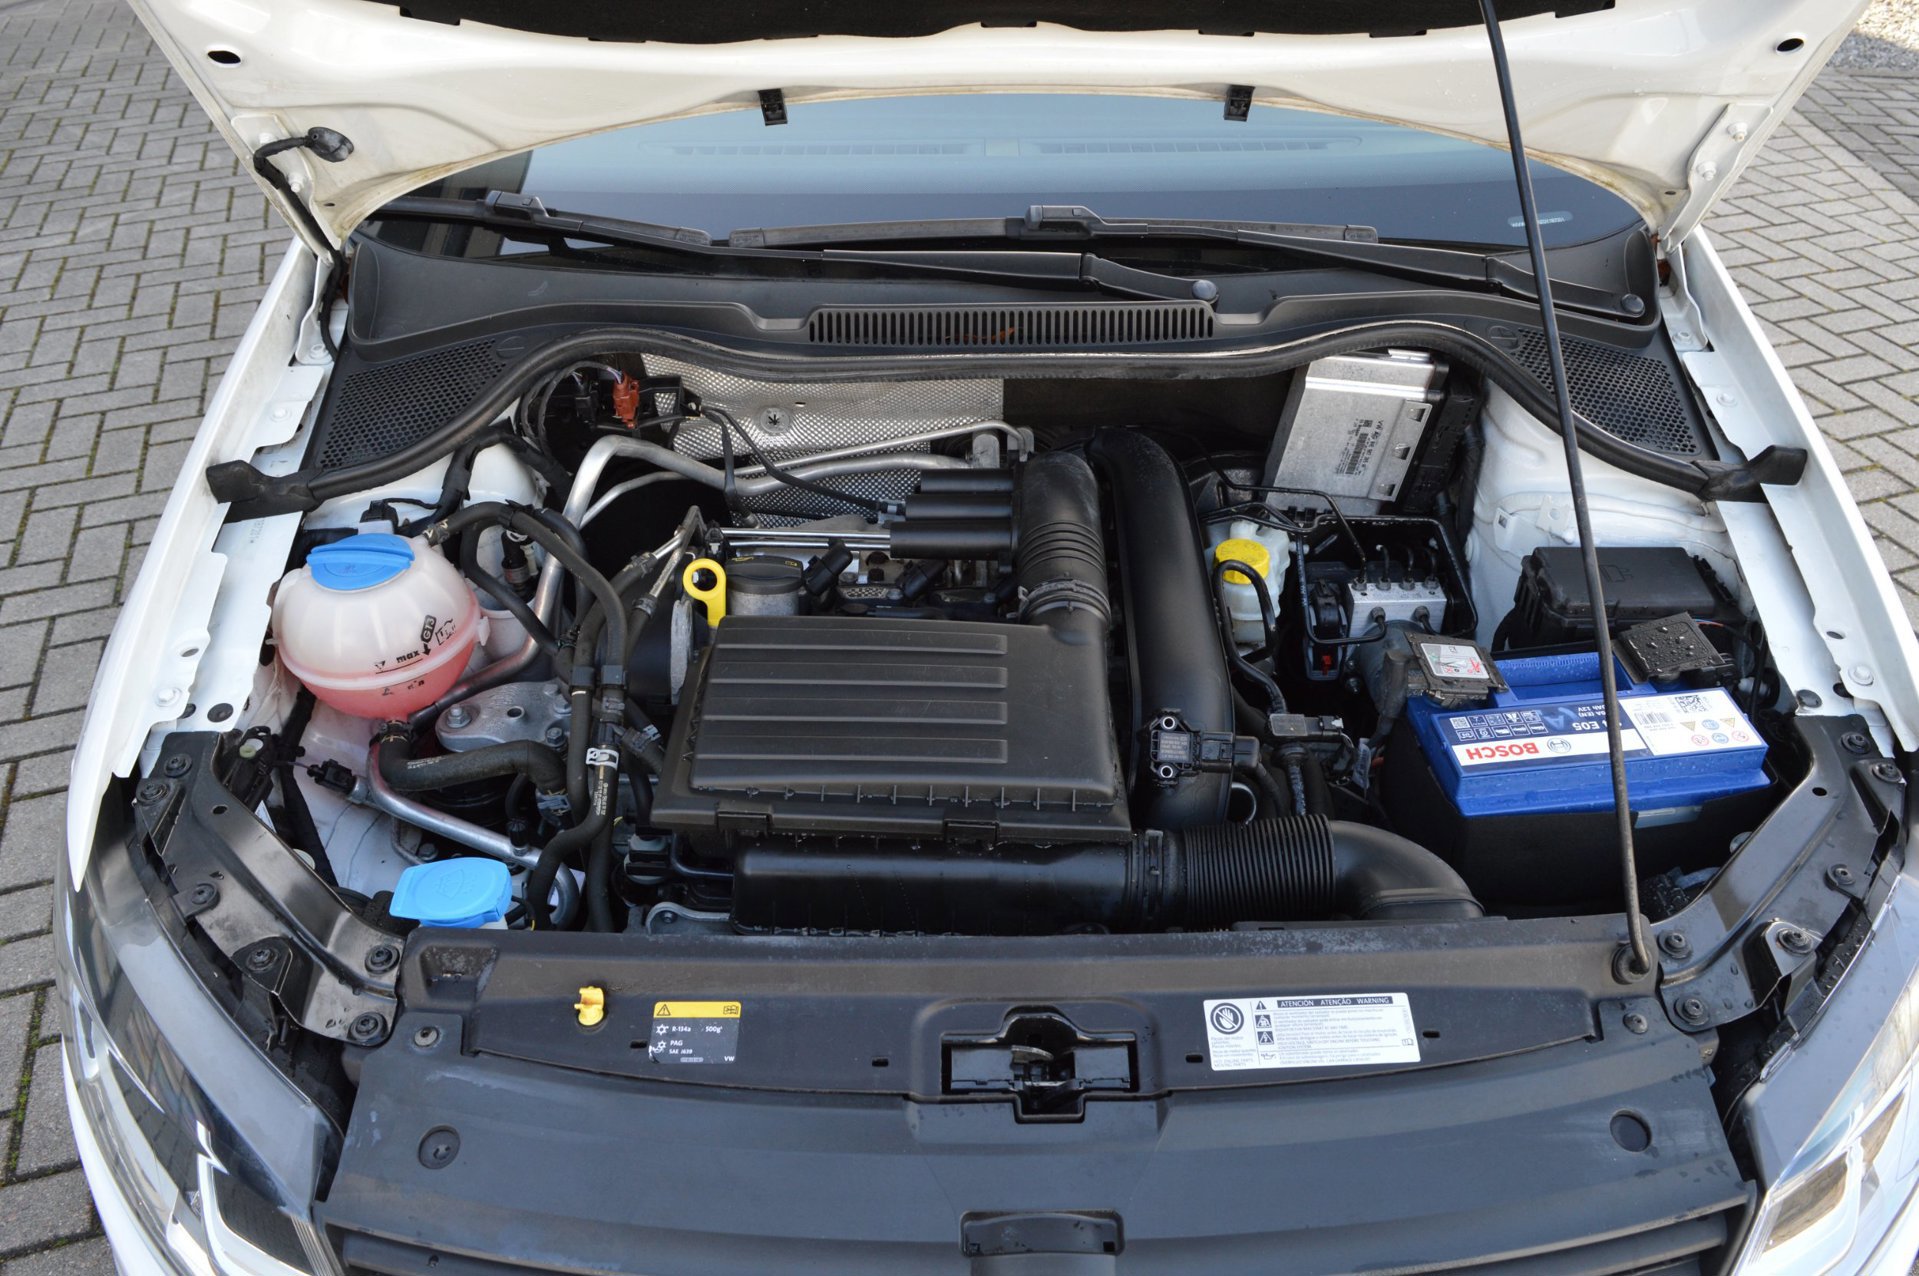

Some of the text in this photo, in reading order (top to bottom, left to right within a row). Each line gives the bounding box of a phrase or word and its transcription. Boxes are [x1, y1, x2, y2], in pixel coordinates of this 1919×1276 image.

[396, 650, 420, 663] max
[1572, 721, 1600, 731] E05
[1465, 742, 1540, 760] BOSCH
[1280, 997, 1390, 1008] ATENCIÓN ATENÇÃO WARNING
